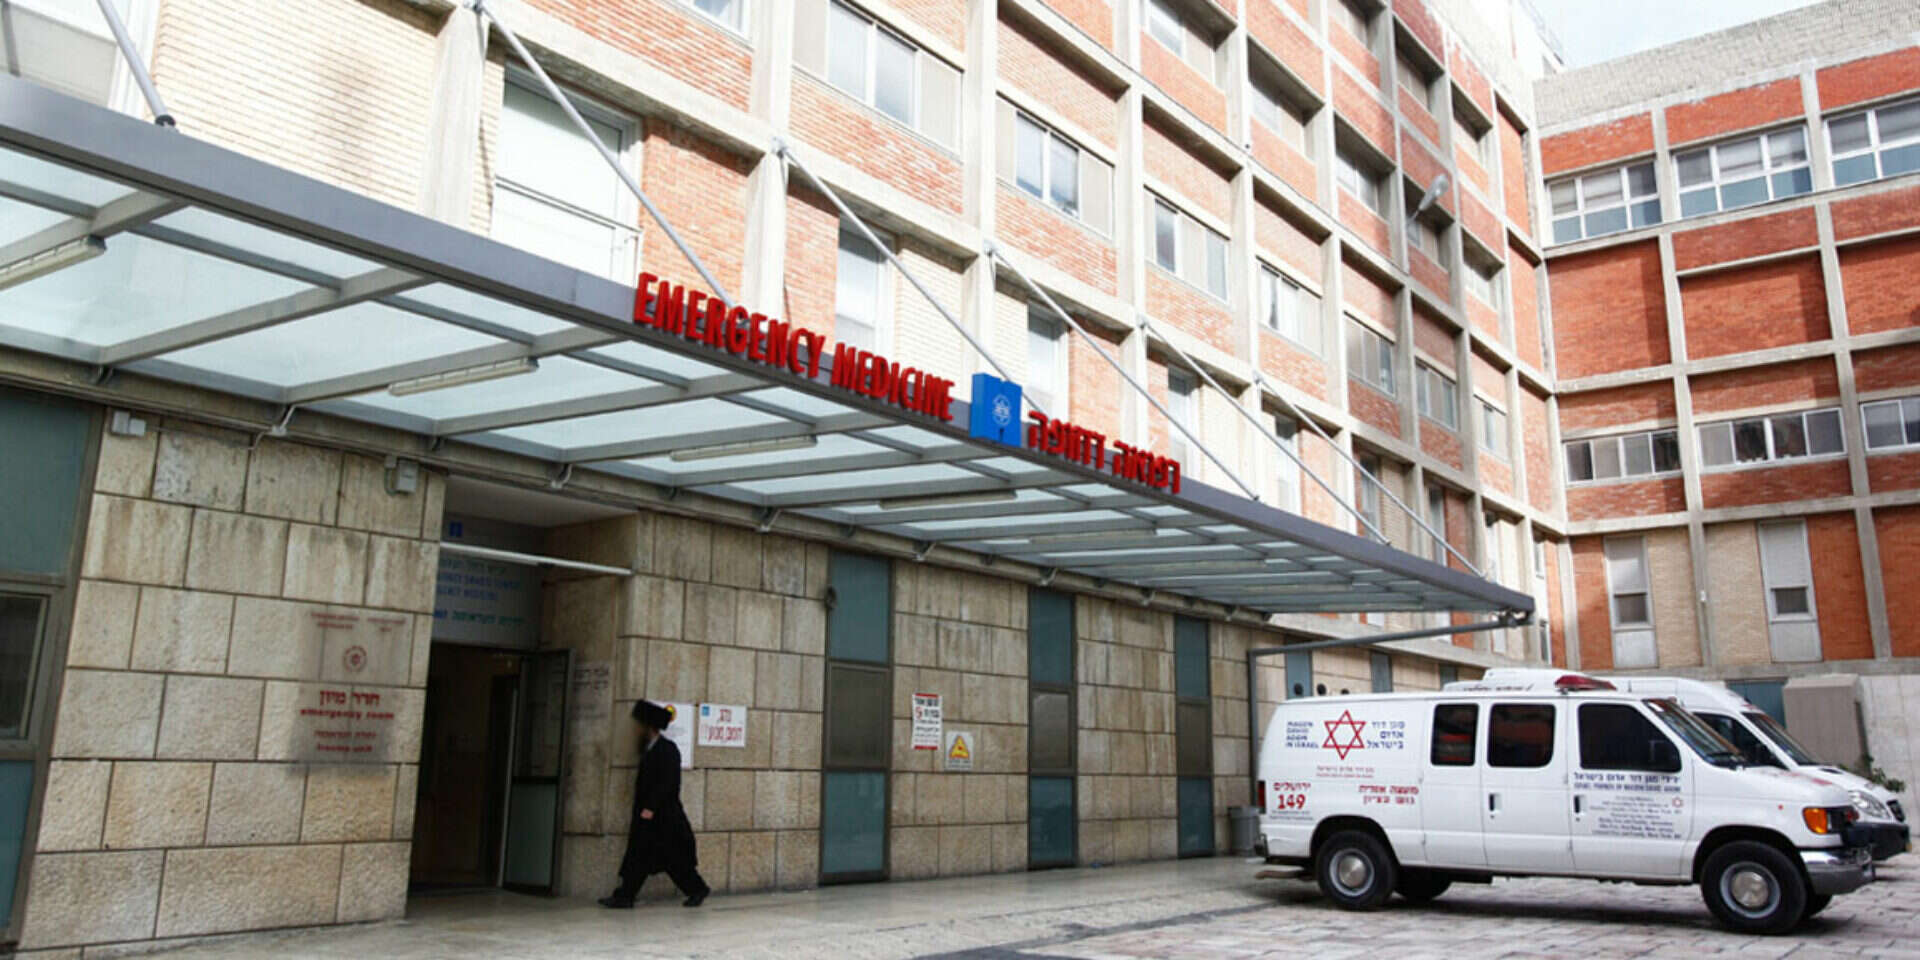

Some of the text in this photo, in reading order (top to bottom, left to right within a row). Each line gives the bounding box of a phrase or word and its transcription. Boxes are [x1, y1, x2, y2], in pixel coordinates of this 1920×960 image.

[633, 272, 955, 421] EMERGENCY MEDICINE
[1027, 410, 1181, 495] רפואה דחופה
[319, 690, 381, 707] חדר מיון
[299, 709, 362, 720] emergency
[1380, 731, 1404, 739] אדום
[1366, 740, 1404, 749] בישראל
[1574, 772, 1604, 780] בישראל
[1645, 775, 1659, 783] מגן
[1273, 782, 1311, 791] ירושלים
[1278, 794, 1306, 810] 149
[1396, 796, 1416, 804] גוש
